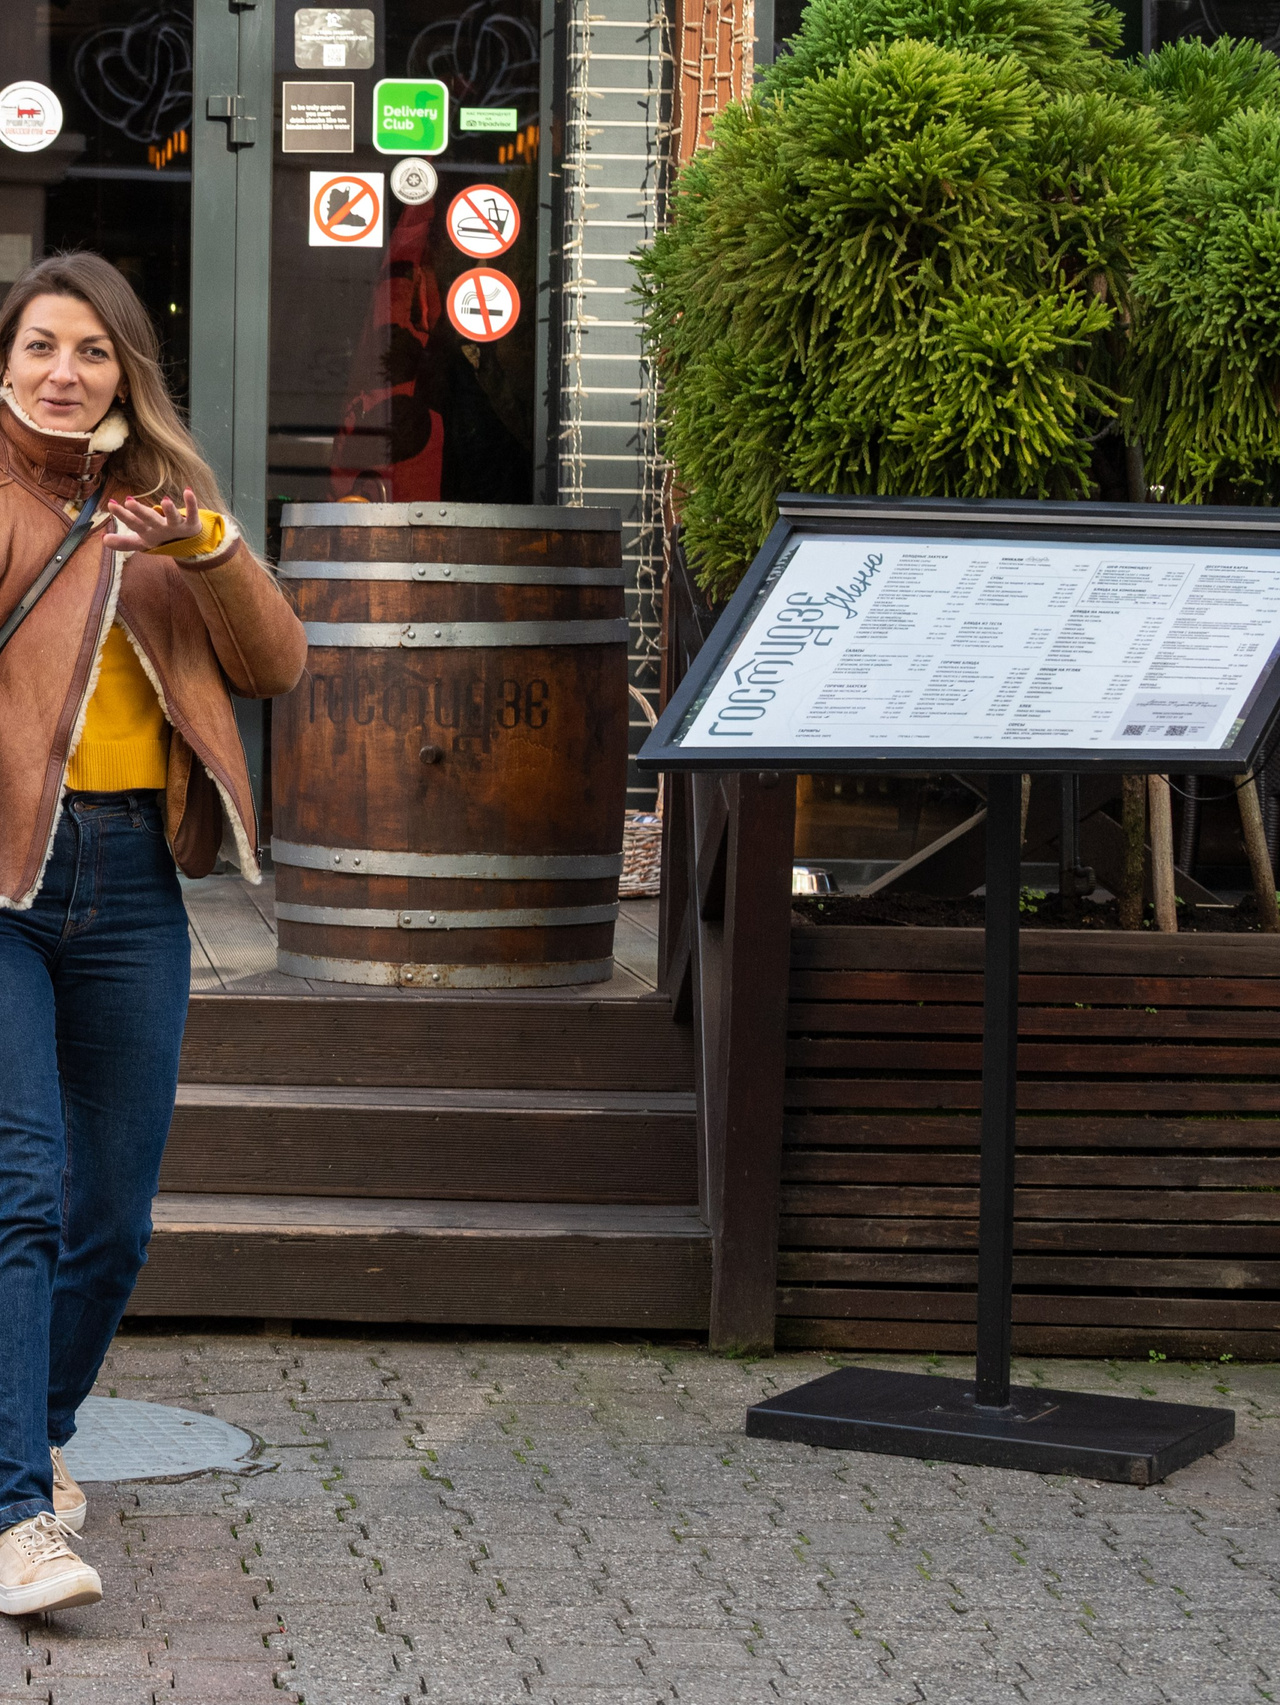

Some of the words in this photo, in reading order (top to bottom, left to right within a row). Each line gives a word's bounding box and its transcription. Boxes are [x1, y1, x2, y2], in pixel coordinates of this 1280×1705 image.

[384, 106, 438, 120] Delivery
[383, 118, 414, 130] Club
[824, 553, 883, 619] Меню
